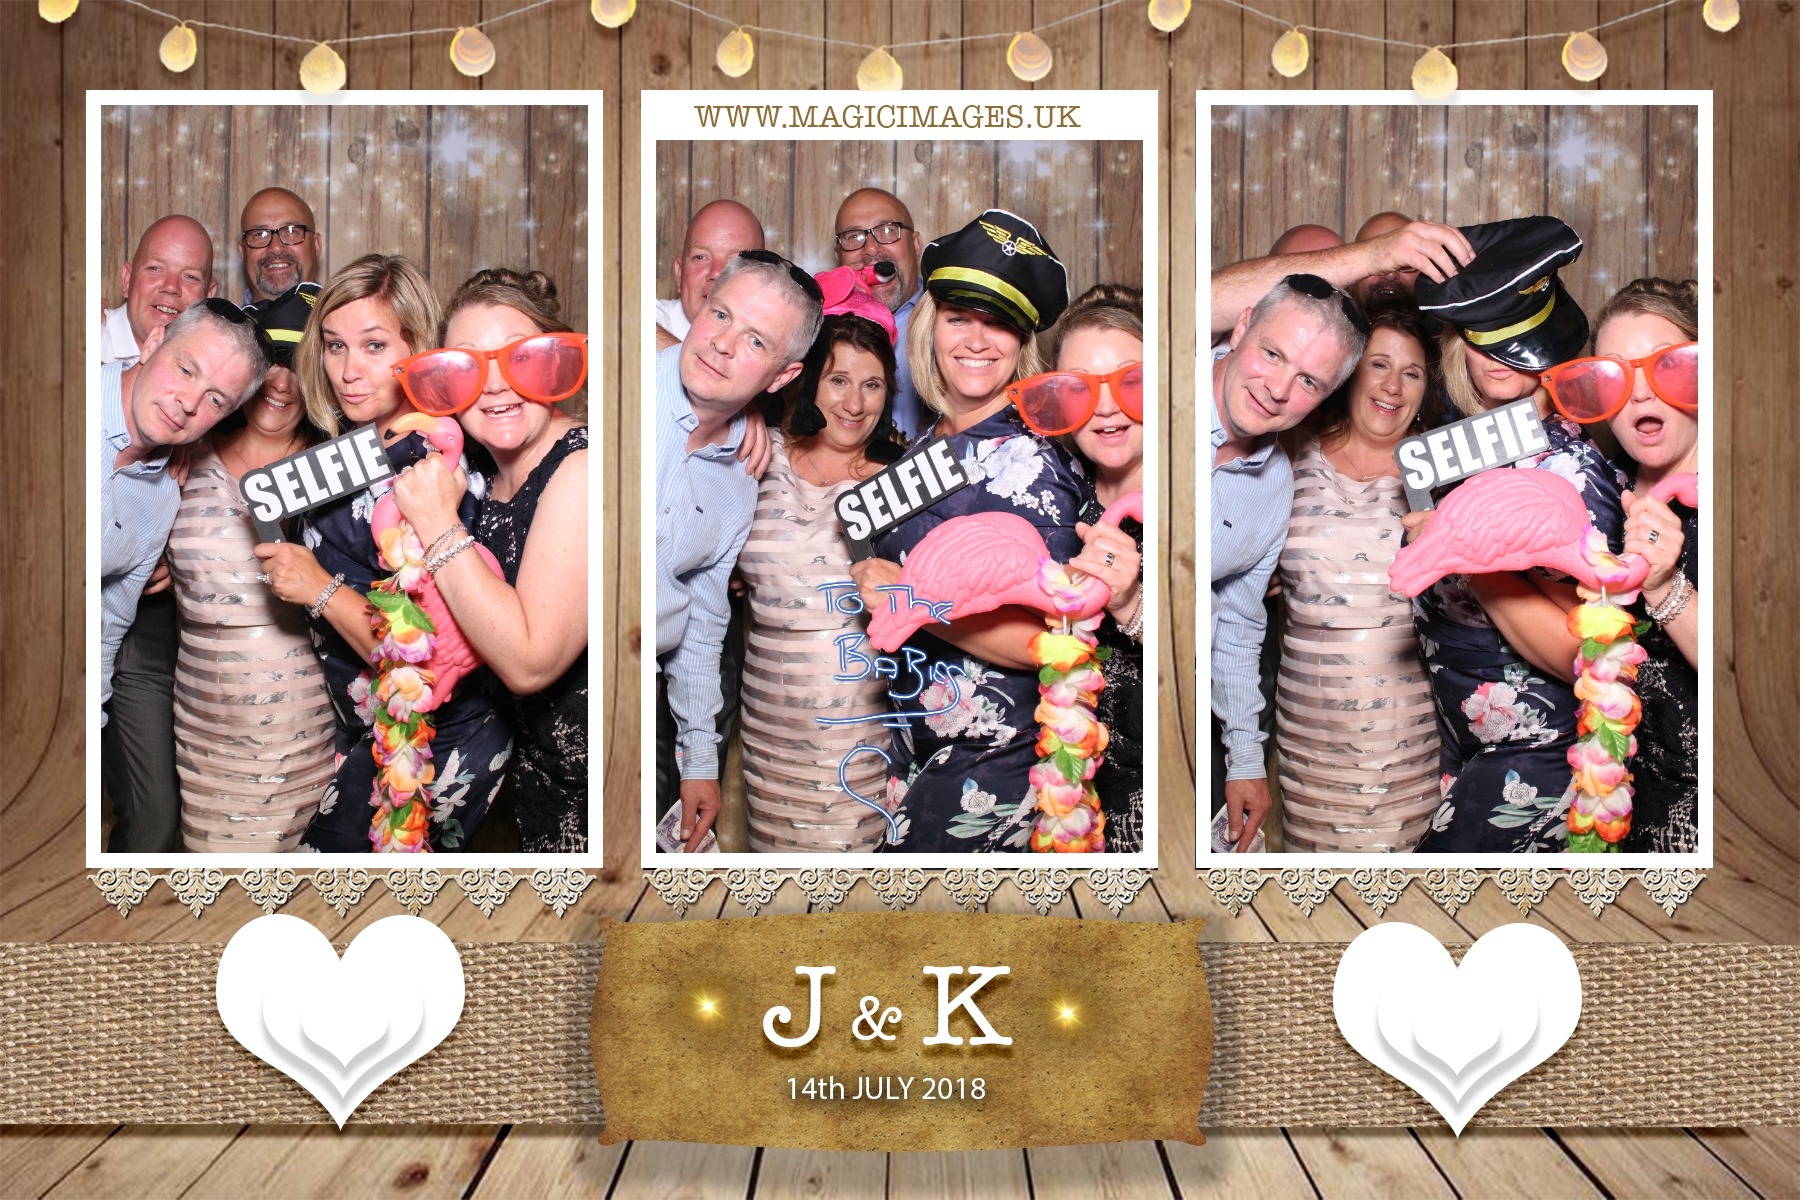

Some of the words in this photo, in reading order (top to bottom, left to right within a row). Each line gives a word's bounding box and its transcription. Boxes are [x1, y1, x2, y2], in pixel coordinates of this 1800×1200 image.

[244, 429, 391, 522] SELFIE
[838, 439, 965, 541] SELFIE
[1399, 402, 1546, 490] SELFIE
